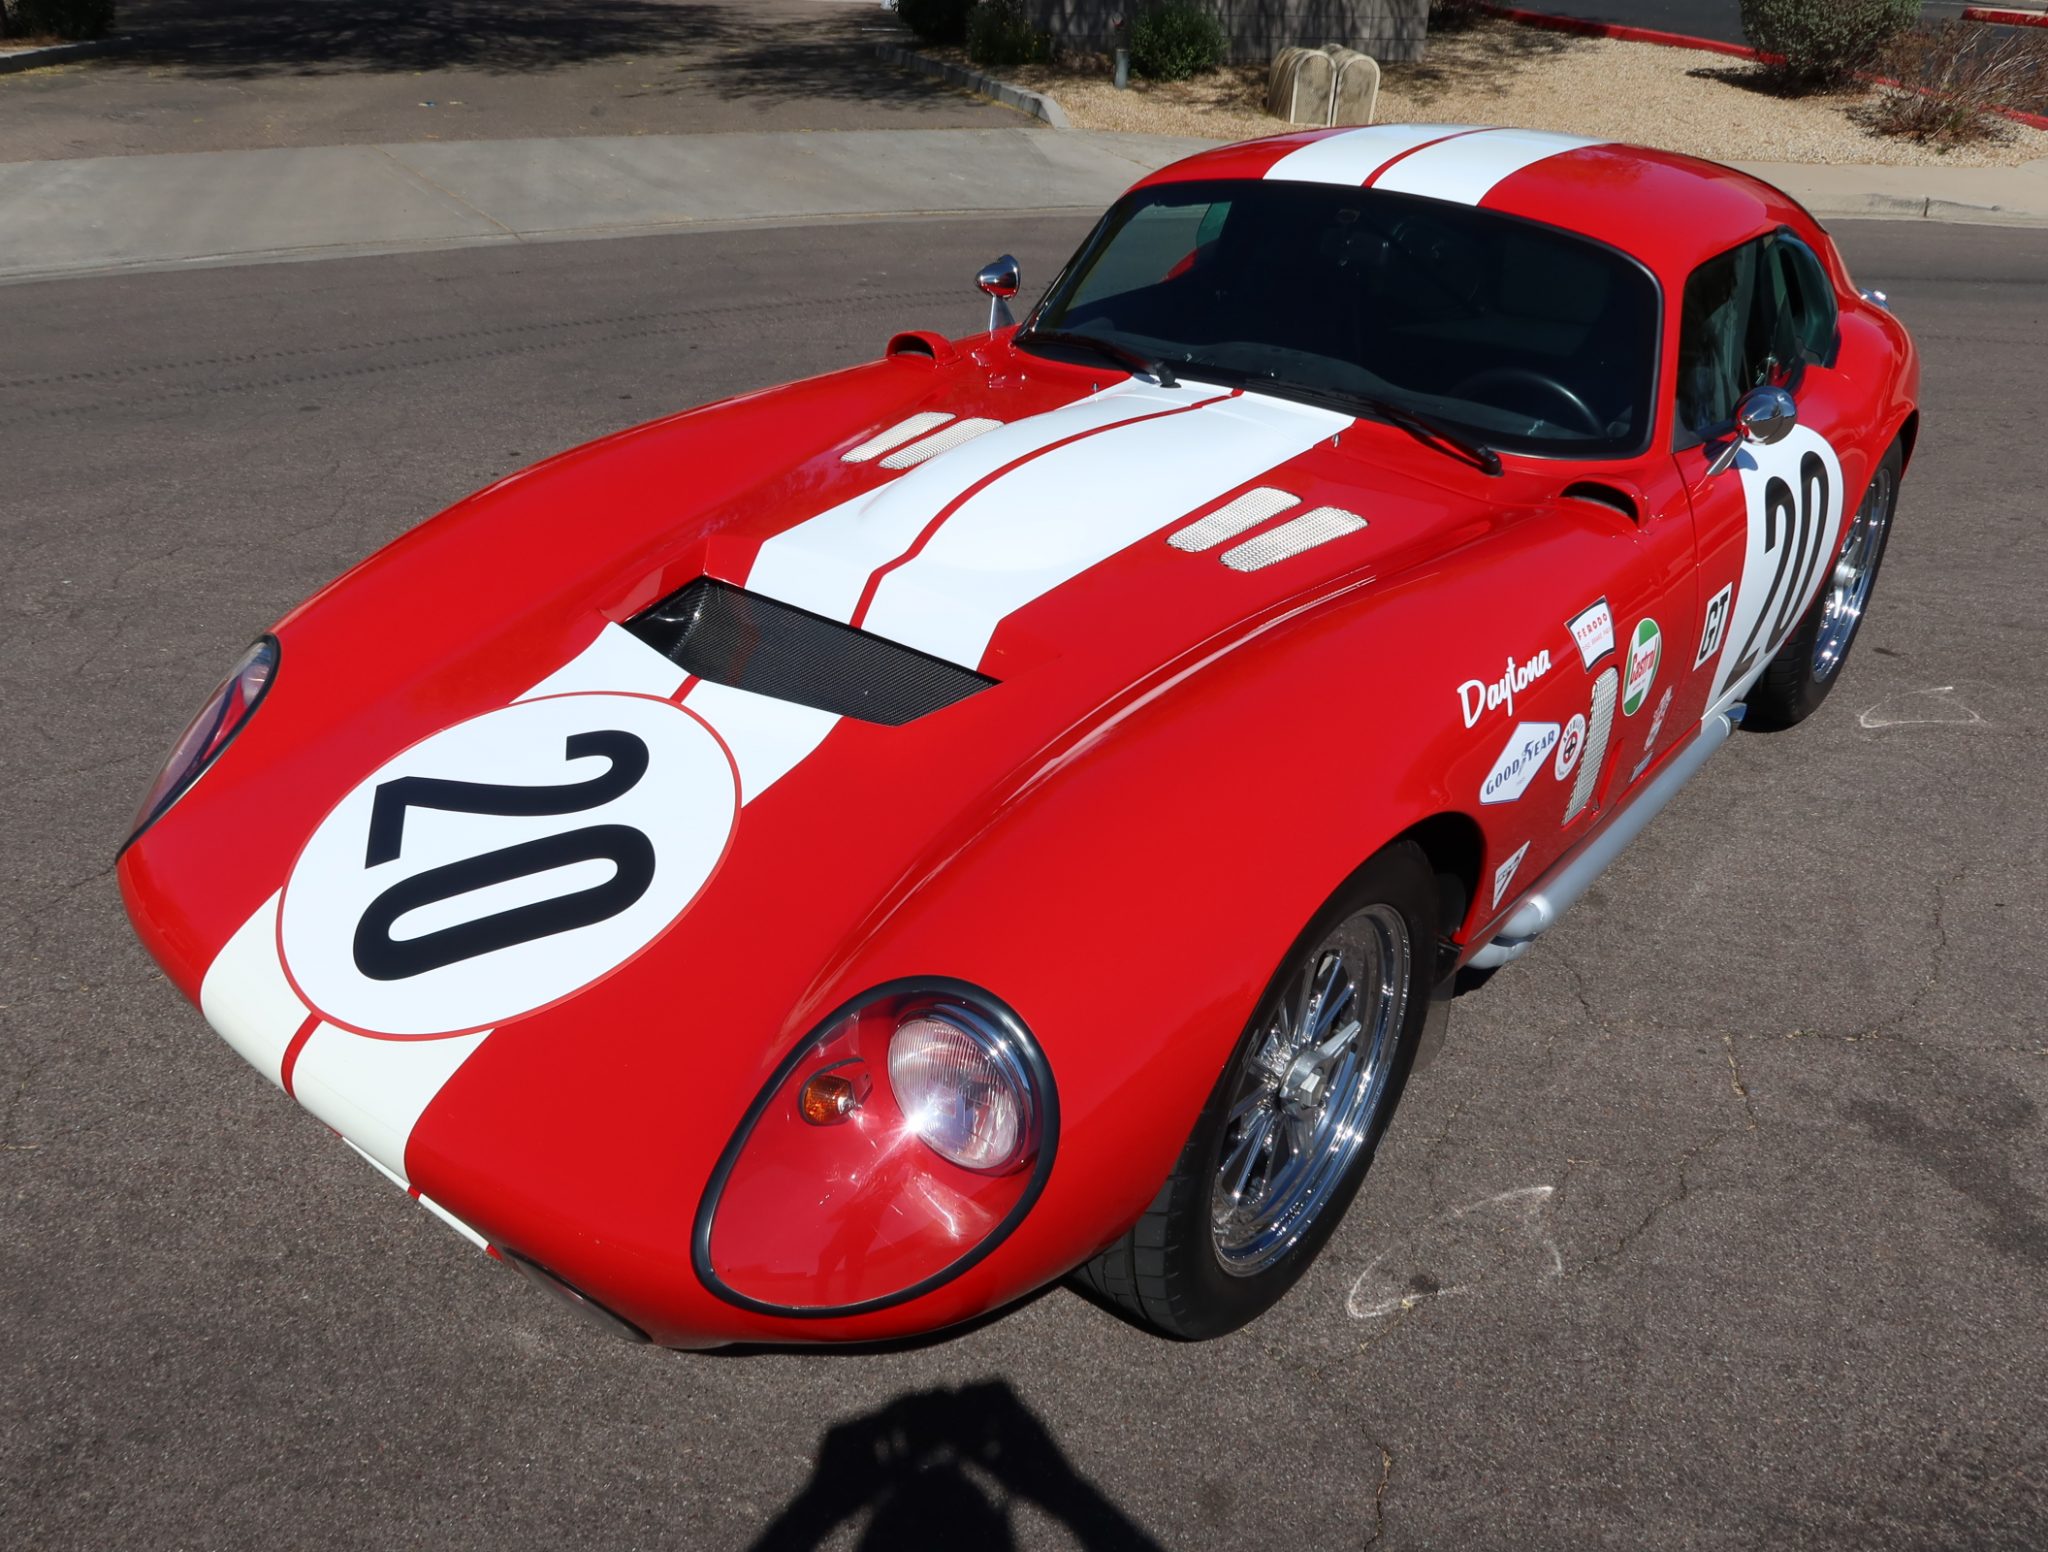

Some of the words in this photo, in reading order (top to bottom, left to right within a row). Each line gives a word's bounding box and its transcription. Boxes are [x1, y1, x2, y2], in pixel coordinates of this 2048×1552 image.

[1719, 451, 1829, 698] 20
[1577, 612, 1608, 641] FERODO
[1699, 591, 1729, 660] GT
[1457, 649, 1552, 729] Daytona
[353, 729, 656, 981] 20
